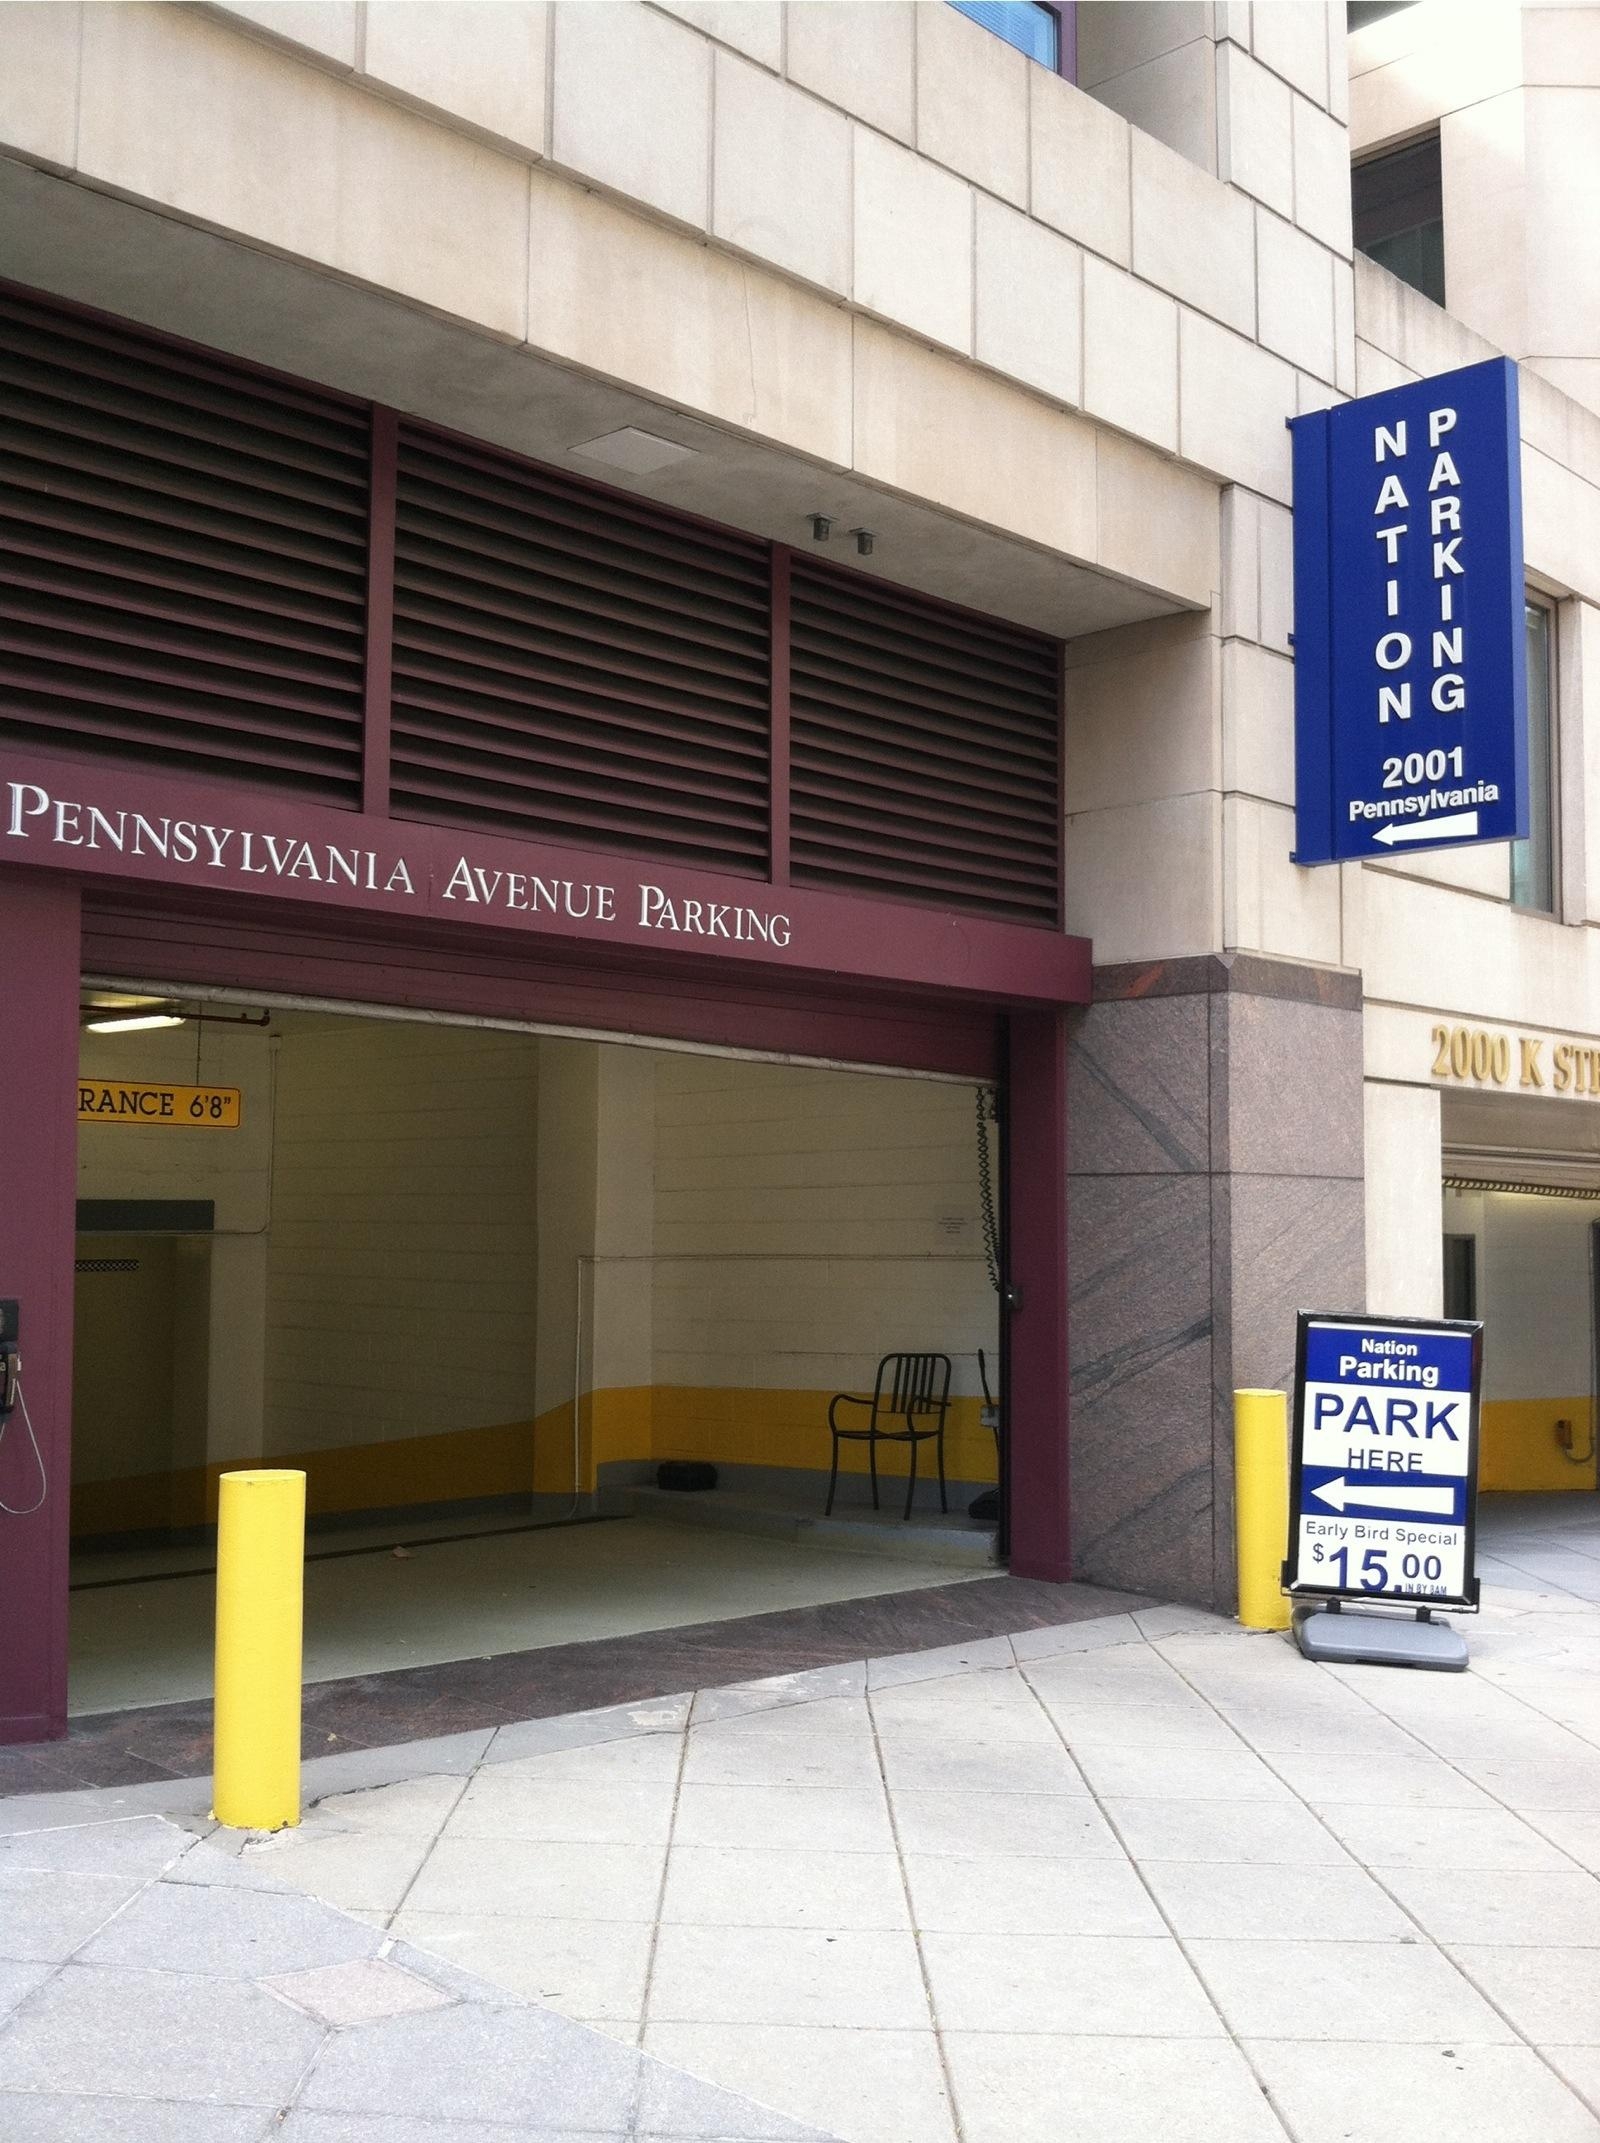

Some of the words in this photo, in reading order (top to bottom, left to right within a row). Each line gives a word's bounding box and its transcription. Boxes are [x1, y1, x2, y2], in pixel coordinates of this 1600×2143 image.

[1374, 420, 1412, 724] NATION
[1428, 407, 1466, 713] PARKING
[1382, 746, 1463, 789] 2001
[1349, 780, 1499, 822] Pennsylvania
[7, 781, 415, 894] PENNSYLVANIA
[442, 856, 616, 921] AVENUE
[638, 884, 792, 947] PARKING
[1431, 1024, 1511, 1084] 2000
[1519, 1037, 1545, 1087] K
[1361, 1338, 1418, 1356] Nation
[1339, 1355, 1439, 1388] Parking
[1313, 1392, 1460, 1442] PARK
[1348, 1448, 1423, 1473] HERE
[1306, 1521, 1348, 1540] Early
[1354, 1525, 1389, 1540] Bird
[1395, 1528, 1457, 1545] Special
